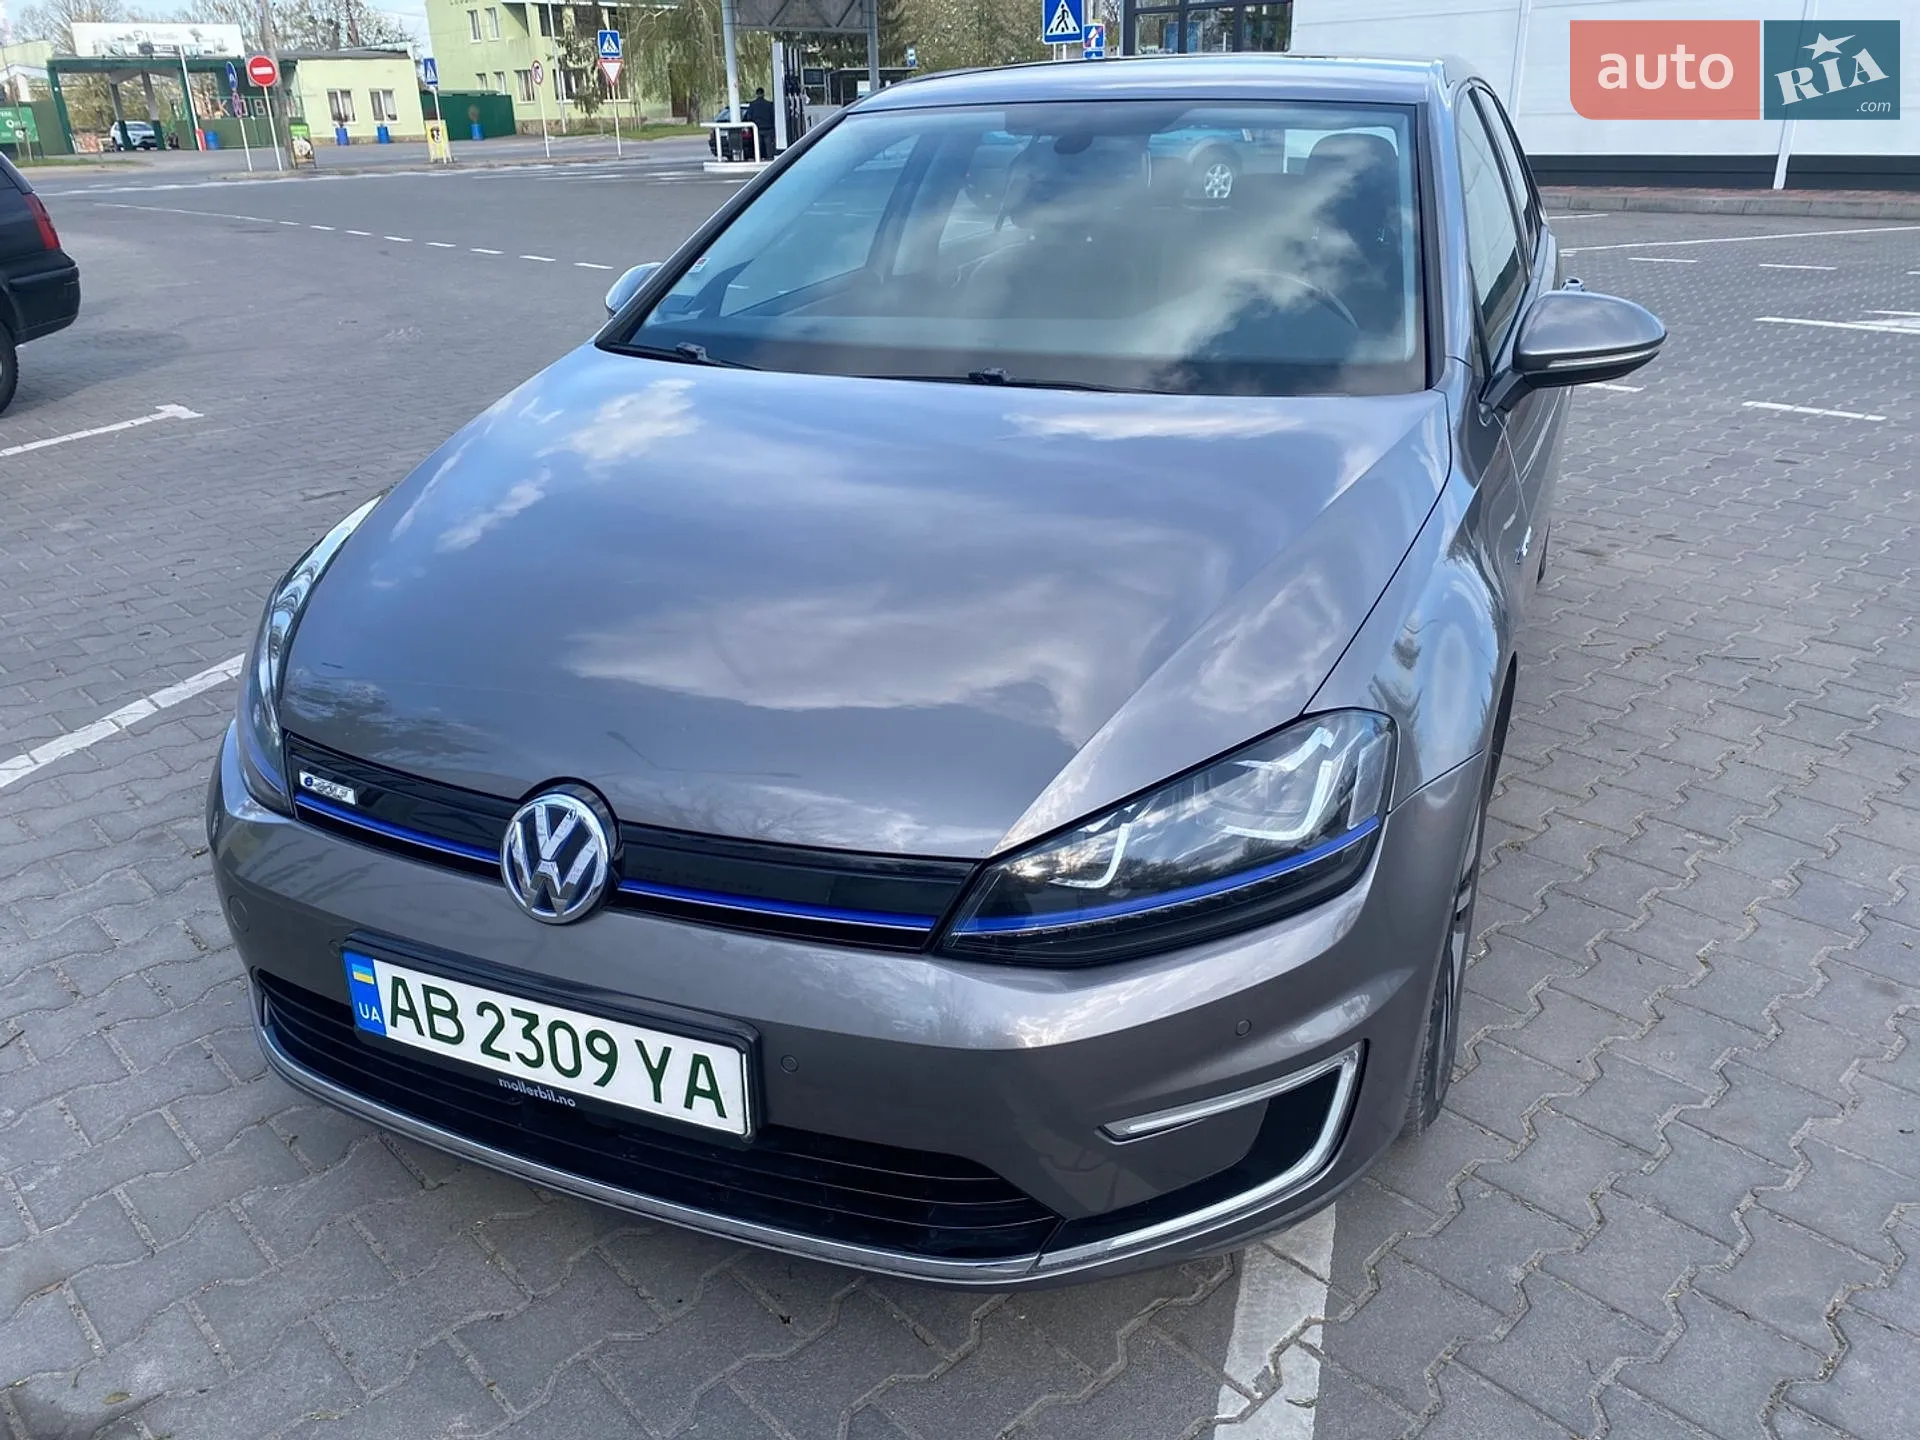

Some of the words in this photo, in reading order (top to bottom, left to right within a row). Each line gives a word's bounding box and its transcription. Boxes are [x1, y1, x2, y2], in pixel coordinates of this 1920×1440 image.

[358, 1001, 382, 1024] UA
[390, 976, 465, 1046] AB
[477, 1002, 619, 1088] 2309
[635, 1040, 728, 1119] YA
[498, 1077, 577, 1108] mollerbil.no
